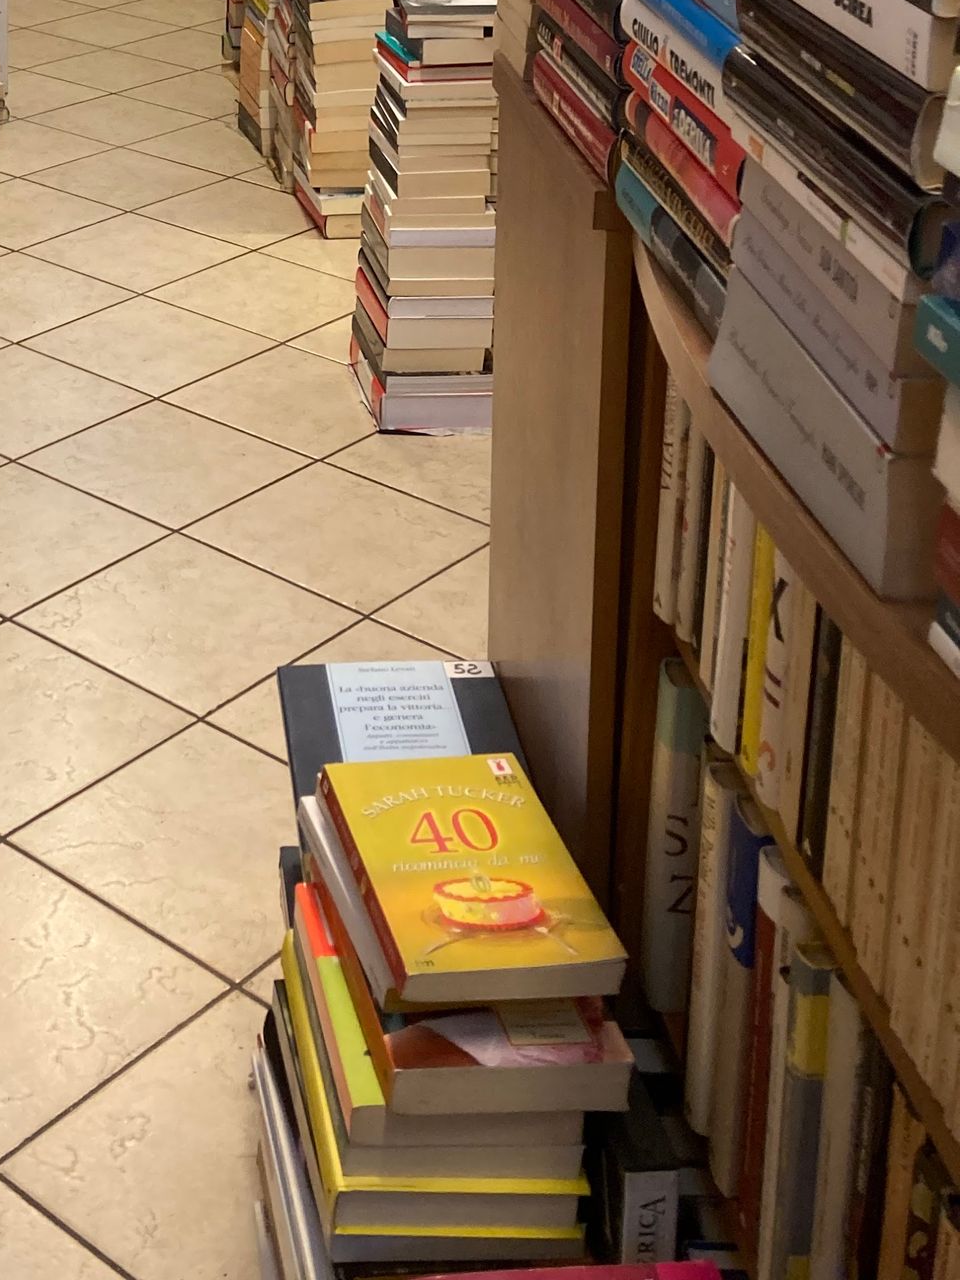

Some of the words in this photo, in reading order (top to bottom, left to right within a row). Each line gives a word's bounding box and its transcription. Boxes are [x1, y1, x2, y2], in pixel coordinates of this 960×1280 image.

[631, 17, 659, 54] GIULIO
[668, 48, 716, 108] TREMONTI
[339, 685, 352, 693] La
[400, 683, 444, 691] azienda
[357, 695, 385, 703] negli
[339, 705, 384, 713] prepara
[362, 785, 429, 819] SARAH
[436, 785, 526, 809] TUCKER
[410, 808, 499, 854] 40
[392, 852, 479, 873] ricomincio
[489, 852, 510, 866] da
[639, 1194, 665, 1264] RICA
